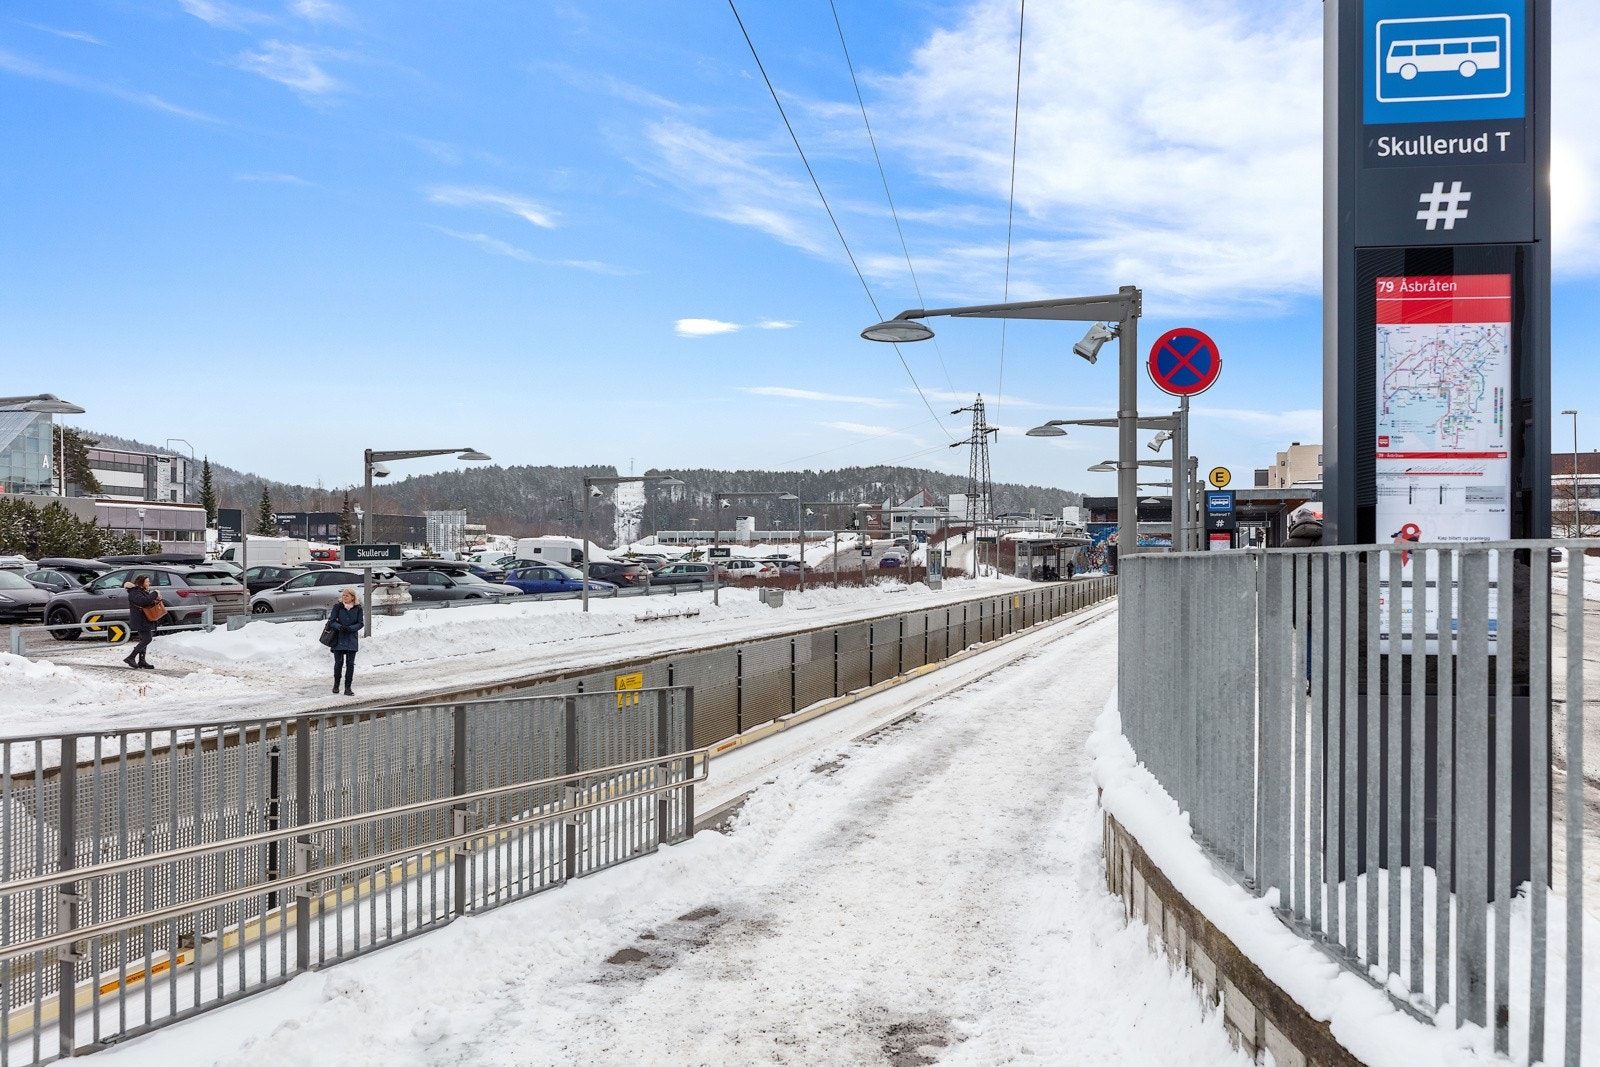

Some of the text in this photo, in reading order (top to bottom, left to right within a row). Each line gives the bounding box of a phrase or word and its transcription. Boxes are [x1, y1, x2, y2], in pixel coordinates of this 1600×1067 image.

[1377, 131, 1511, 157] Skullerud T
[1378, 278, 1457, 293] 79 Åsbråten
[42, 454, 49, 469] A
[1216, 472, 1224, 483] E
[357, 548, 389, 557] Skullerud
